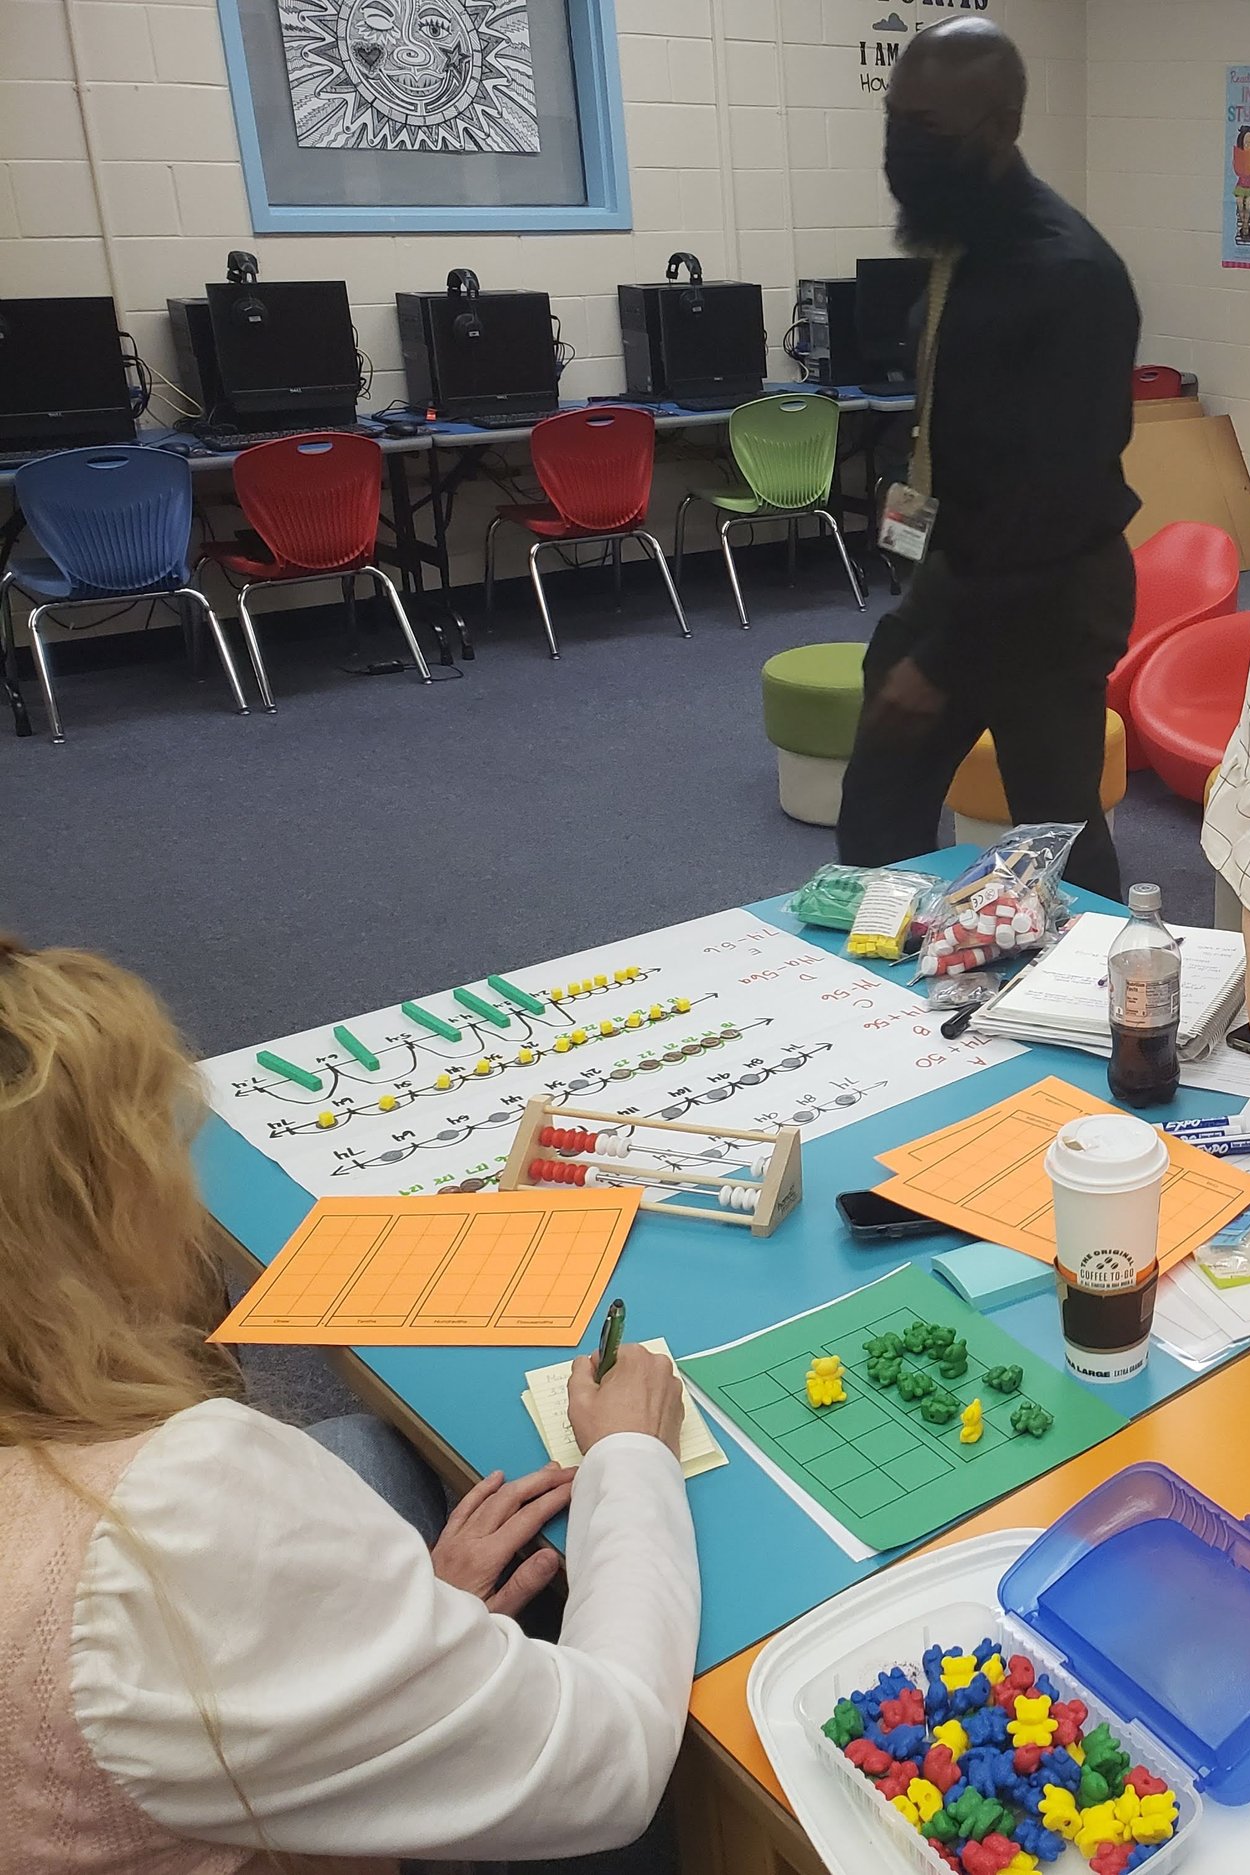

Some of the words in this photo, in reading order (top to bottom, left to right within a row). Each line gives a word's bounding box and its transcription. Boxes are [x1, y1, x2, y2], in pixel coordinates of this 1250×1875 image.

[875, 42, 899, 66] AM
[853, 998, 873, 1009] C
[913, 1025, 931, 1037] B
[915, 1052, 946, 1069] 50
[1165, 1119, 1202, 1132] EXPO
[332, 1147, 367, 1161] 74
[1080, 1253, 1093, 1268] THE
[1093, 1249, 1134, 1266] ORIGINAL
[1080, 1269, 1108, 1282] COFFEE
[1111, 1268, 1134, 1281] TO-GO
[1076, 1367, 1111, 1379] LARGE
